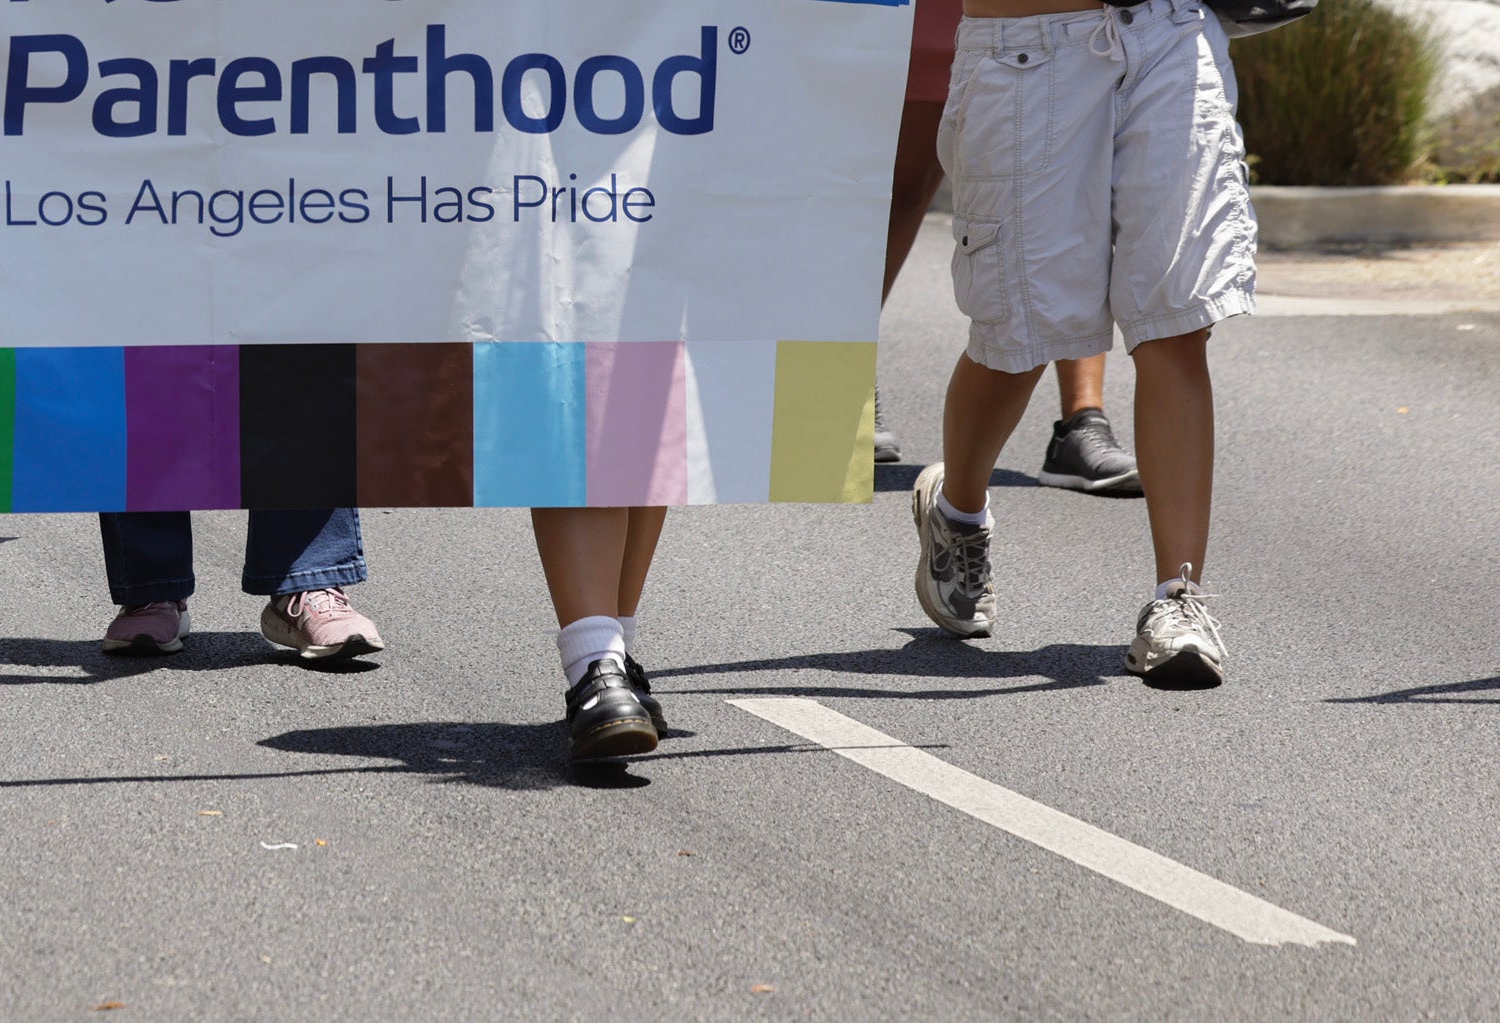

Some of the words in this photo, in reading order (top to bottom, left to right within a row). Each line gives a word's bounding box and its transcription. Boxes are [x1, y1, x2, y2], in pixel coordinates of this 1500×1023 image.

[5, 179, 107, 226] Los
[125, 179, 371, 238] Angeles
[386, 176, 496, 224] Has
[512, 173, 657, 224] Pride
